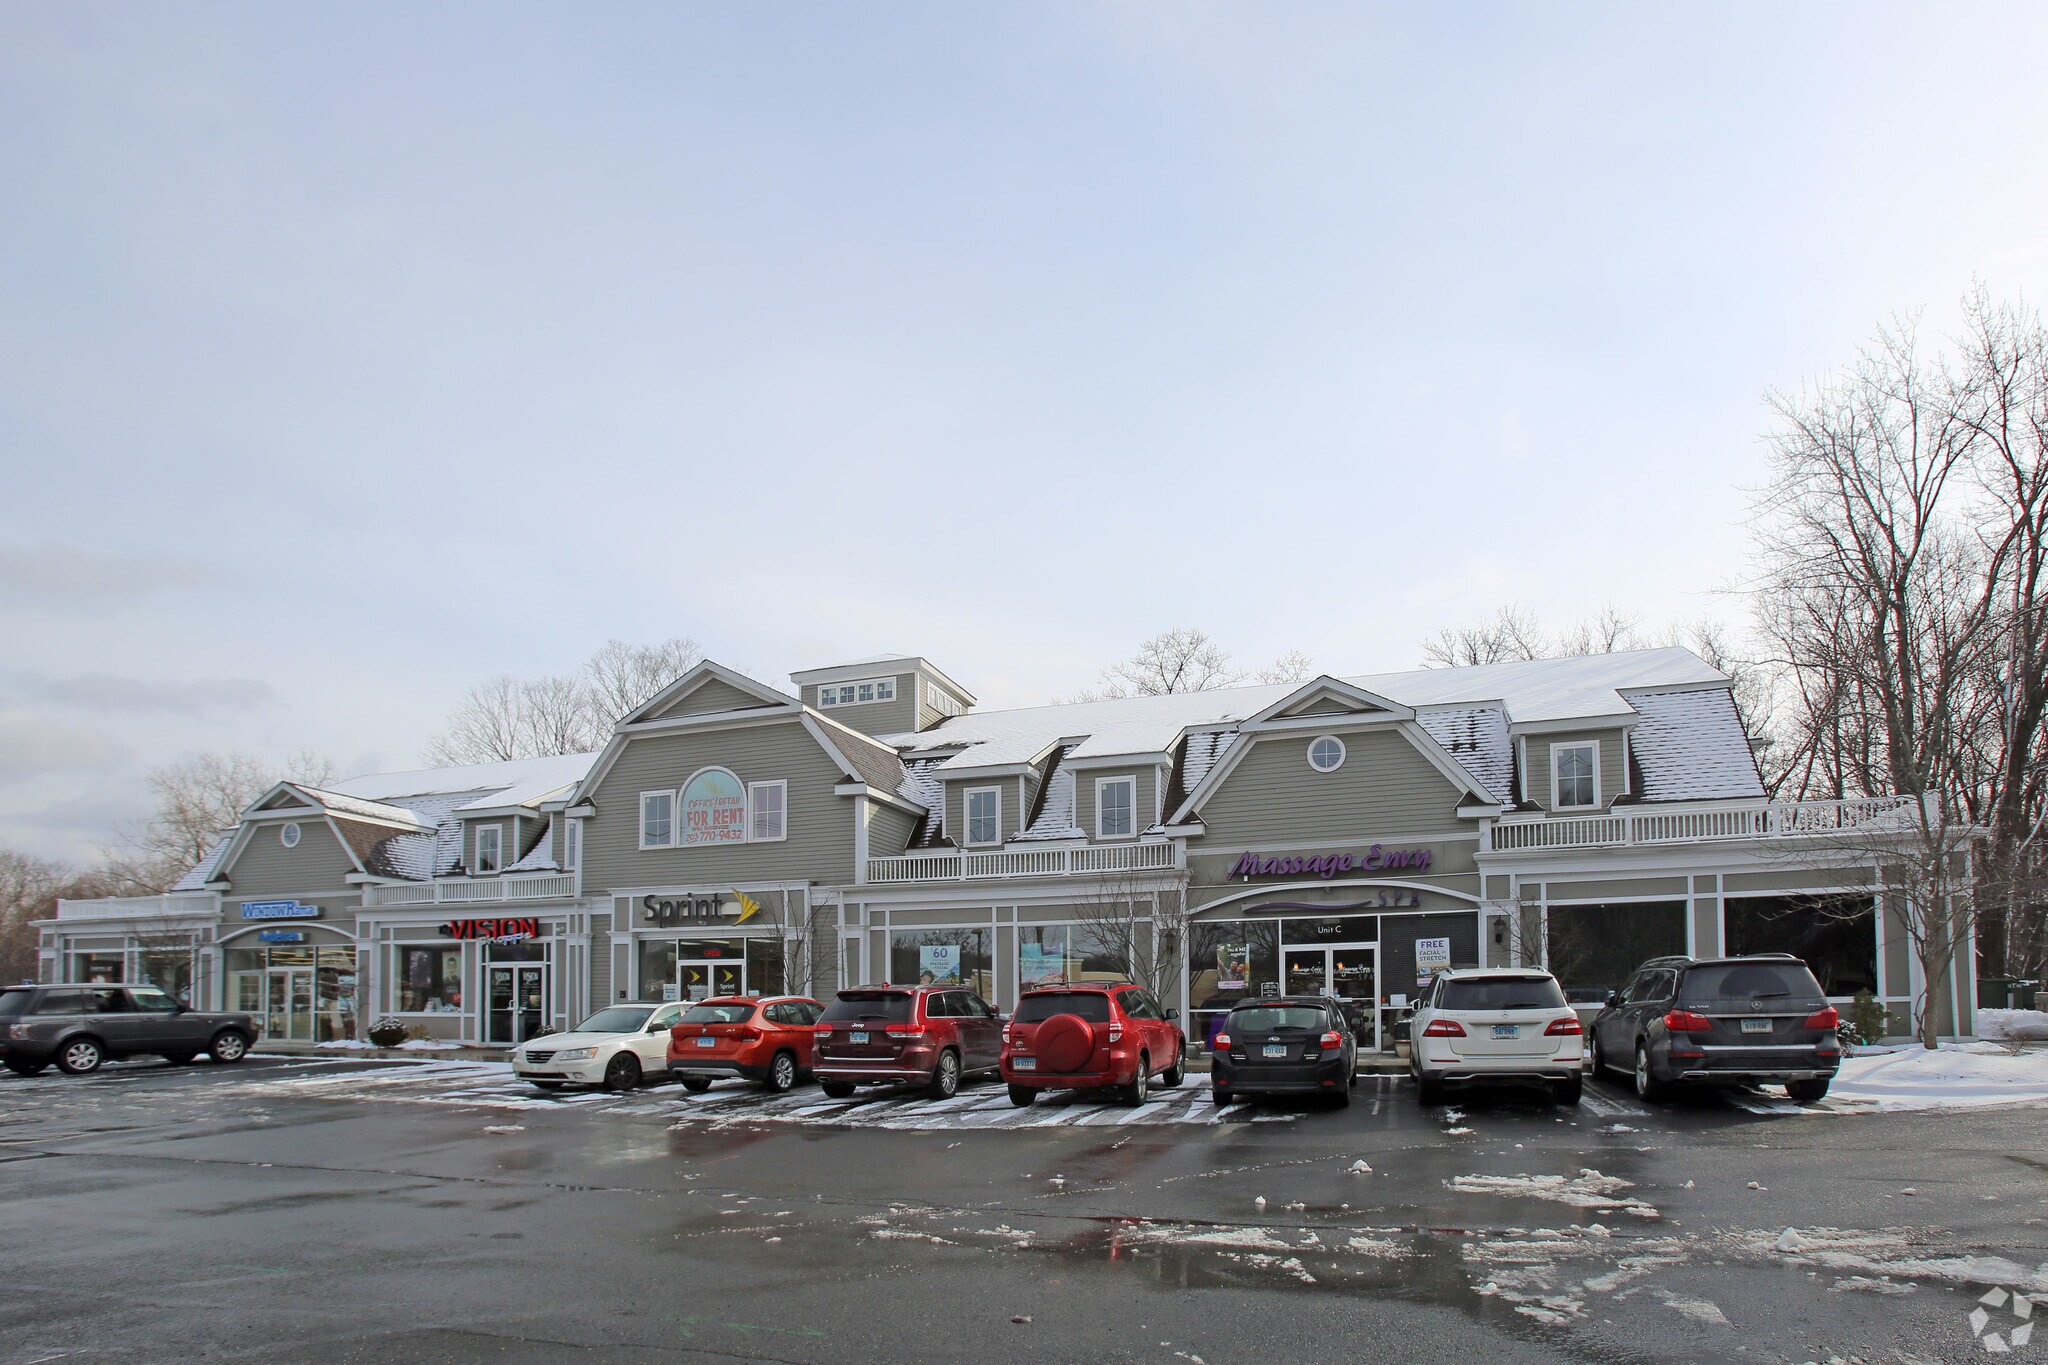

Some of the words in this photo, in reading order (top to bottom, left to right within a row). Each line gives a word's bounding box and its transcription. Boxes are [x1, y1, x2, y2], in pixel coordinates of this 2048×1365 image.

[687, 810, 708, 826] FOR
[713, 808, 744, 825] RENT
[1226, 851, 1352, 880] Massage
[1361, 844, 1432, 874] Envy
[1378, 889, 1420, 908] SPA
[643, 892, 723, 928] Sprint
[450, 917, 538, 939] VISION
[1317, 925, 1334, 934] Unit
[1335, 925, 1342, 934] C
[1420, 940, 1444, 948] FREE
[720, 983, 735, 991] Sprint
